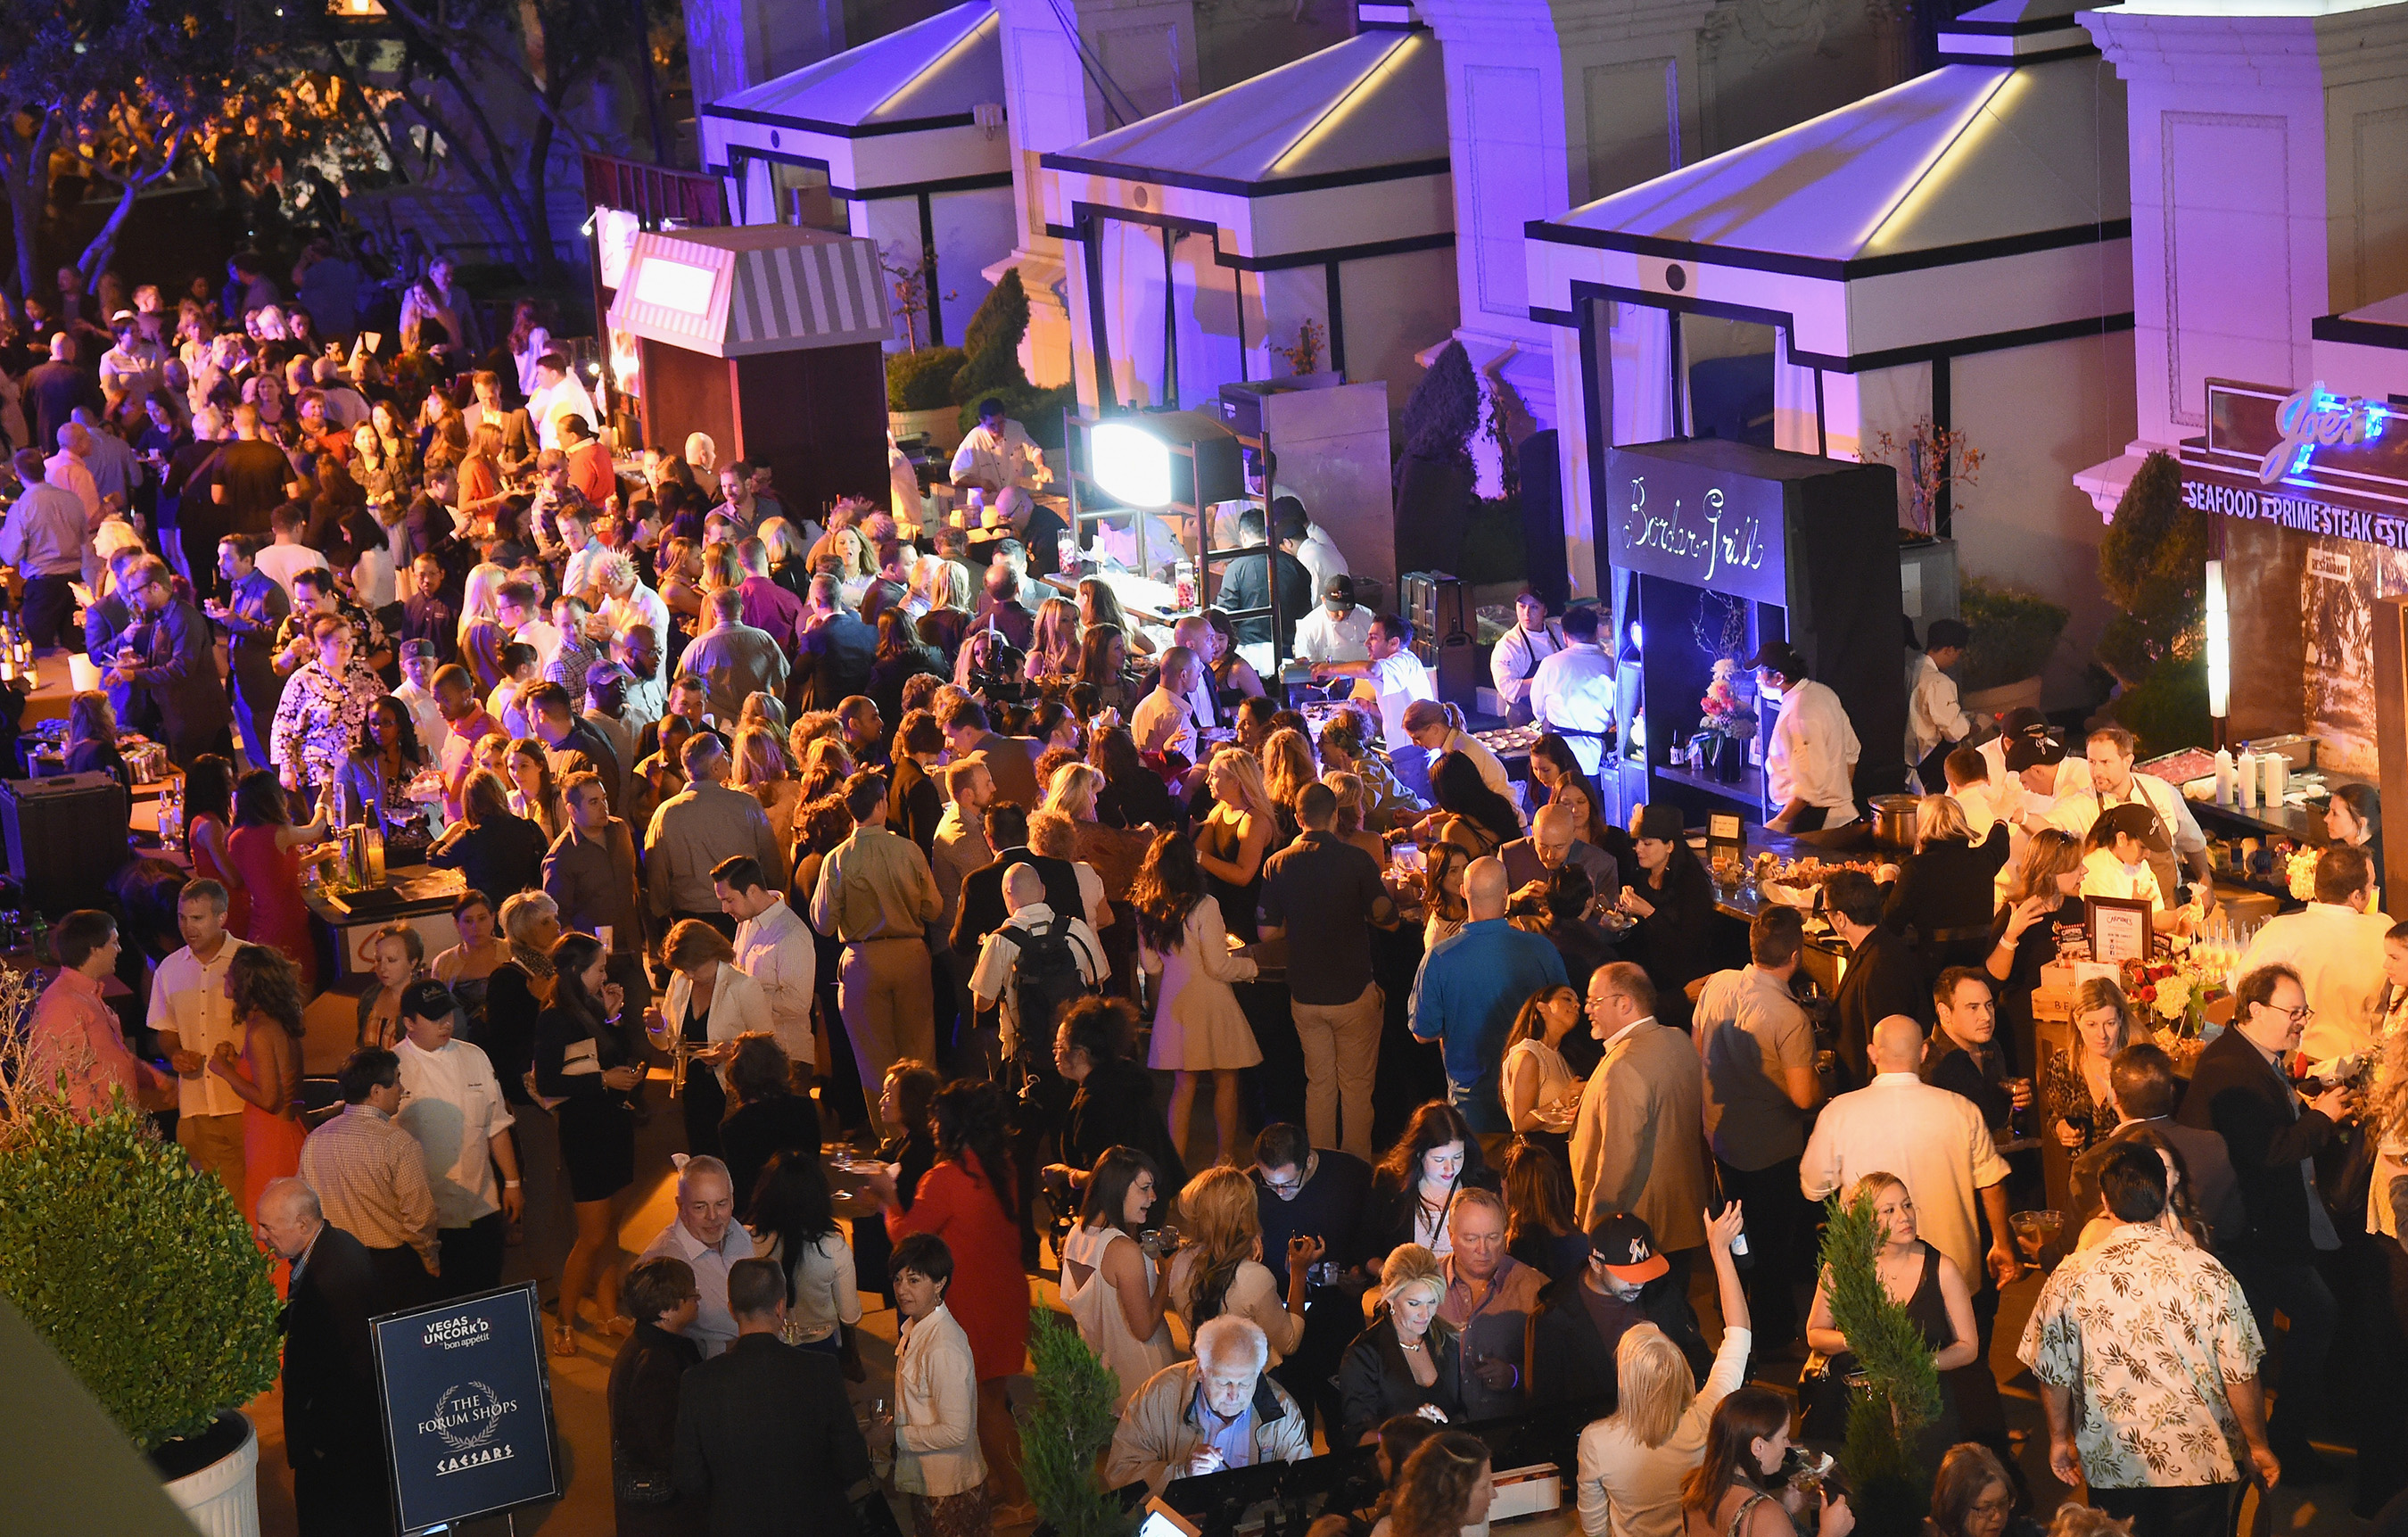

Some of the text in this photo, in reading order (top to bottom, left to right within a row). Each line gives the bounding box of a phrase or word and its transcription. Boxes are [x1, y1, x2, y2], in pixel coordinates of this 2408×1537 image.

[2259, 382, 2359, 484] Joe's
[2188, 481, 2257, 520] SEAFOOD
[2273, 497, 2320, 533] PRIME
[2321, 507, 2373, 542] STEAK
[1622, 476, 1764, 581] Border Grill
[2312, 558, 2347, 577] RESTAURANT
[424, 1318, 489, 1345] UNCORK'D
[426, 1316, 468, 1334] VEGAS
[443, 1332, 490, 1350] bon appétit
[417, 1400, 518, 1434] FORUM SHOPS
[451, 1394, 481, 1412] THE
[436, 1443, 513, 1472] CAESARS
